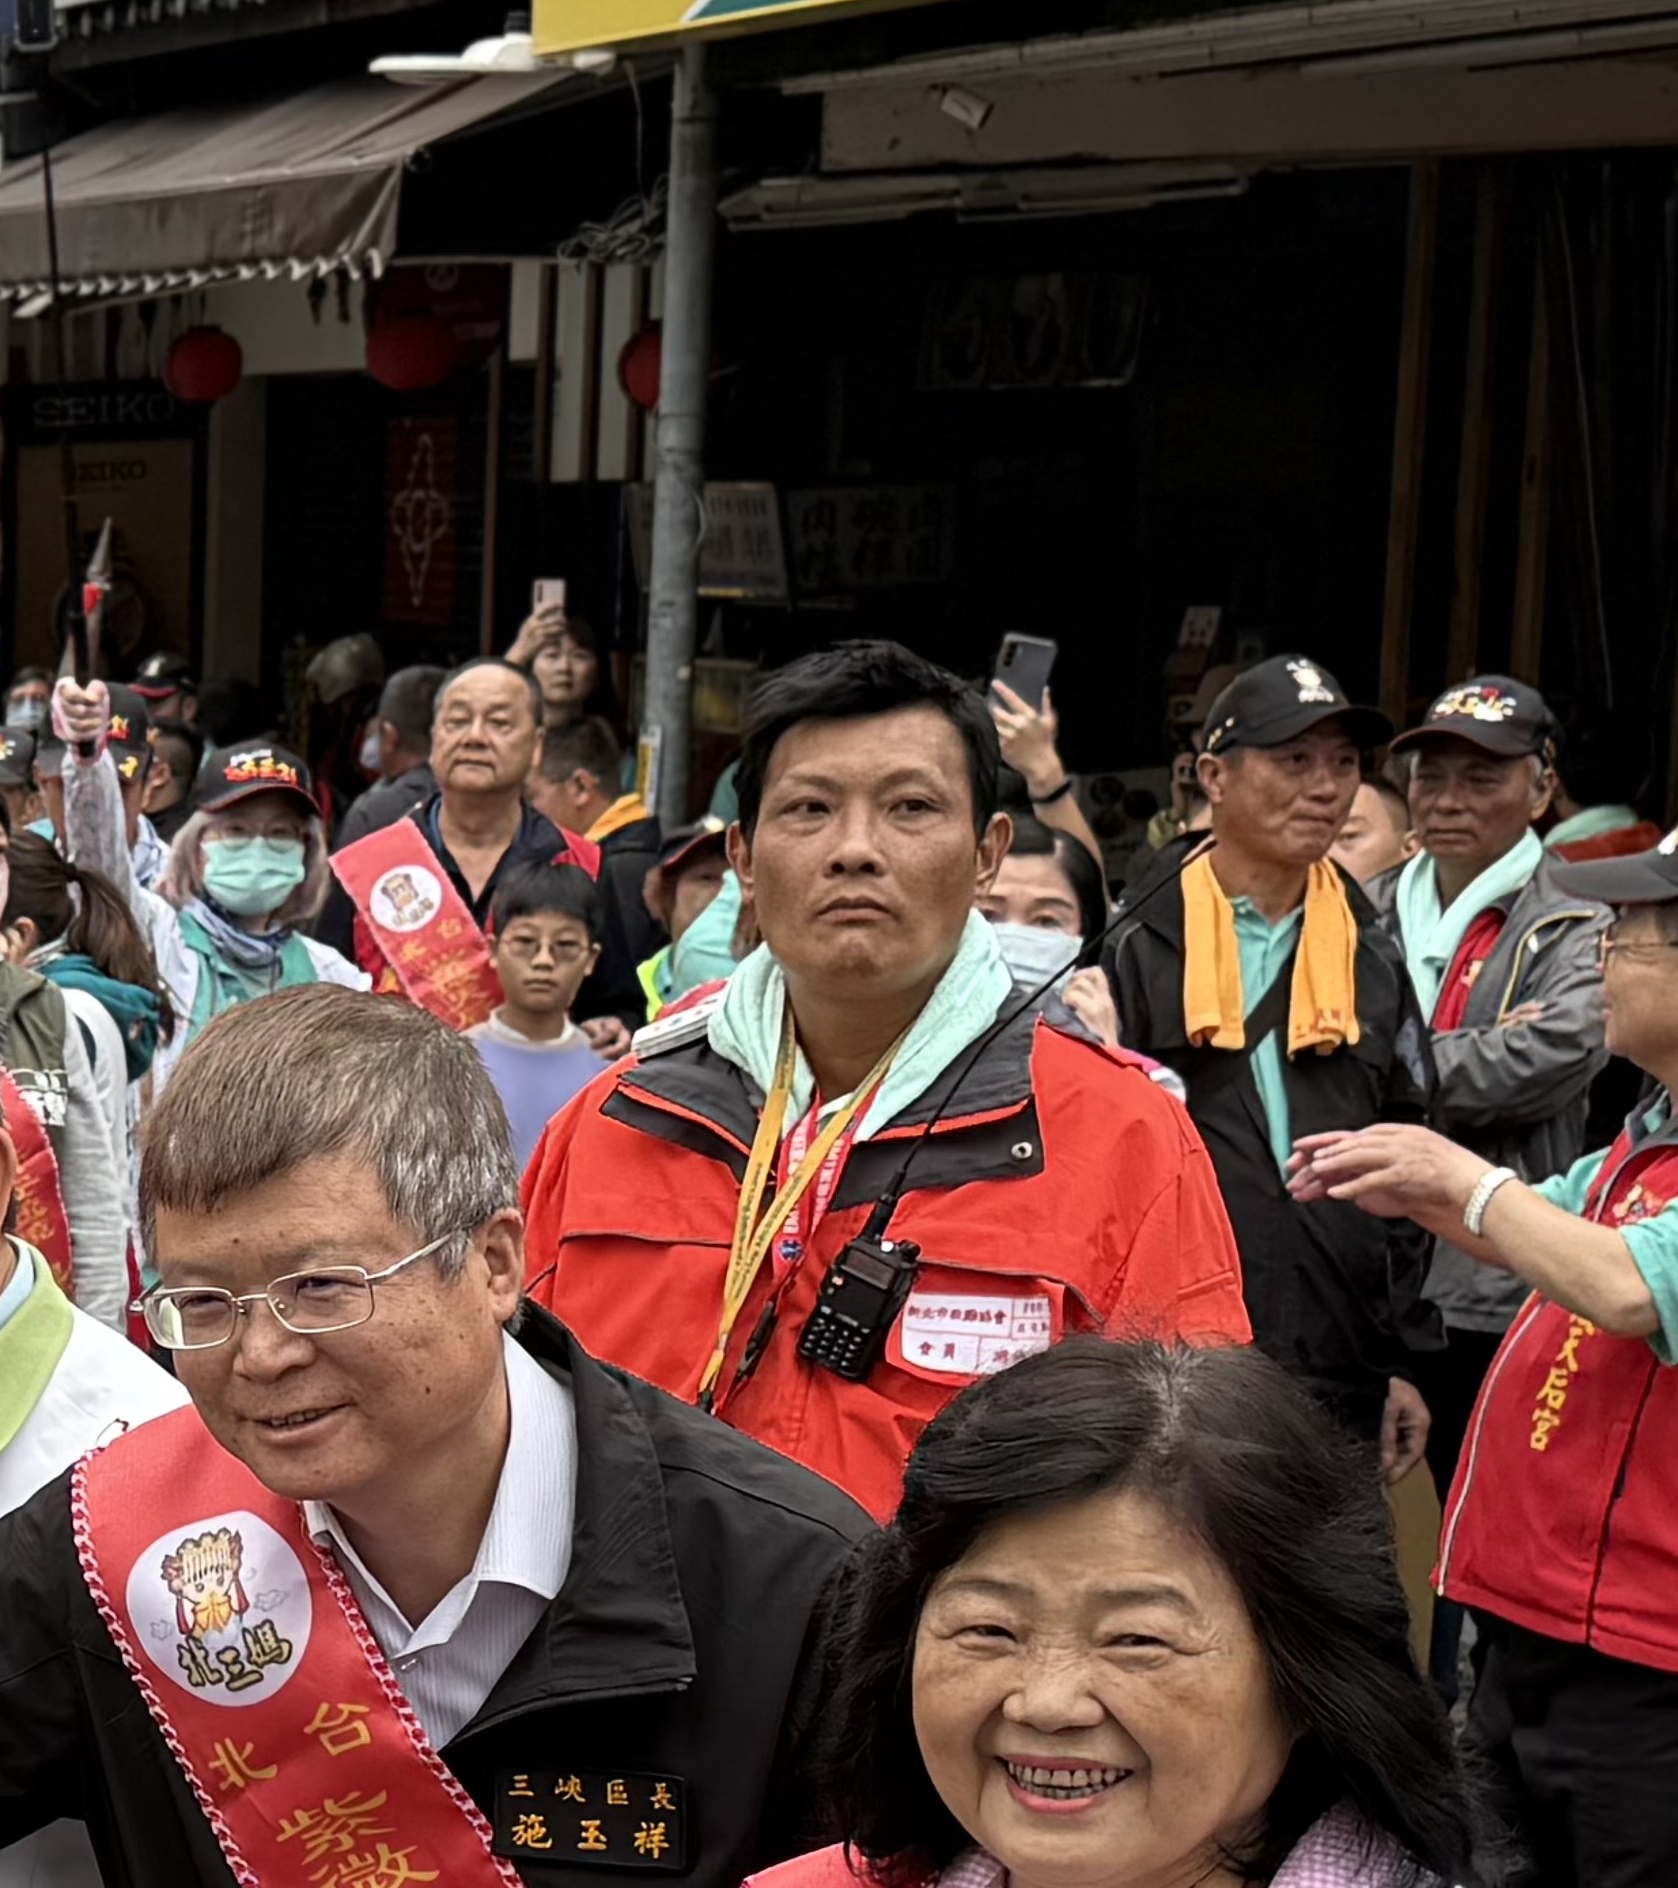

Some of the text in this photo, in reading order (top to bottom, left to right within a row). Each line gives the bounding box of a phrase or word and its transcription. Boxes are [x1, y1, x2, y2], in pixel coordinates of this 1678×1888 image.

[177, 1620, 293, 1691] 北三媽
[509, 1774, 676, 1810] 三峽區長
[512, 1814, 669, 1859] 施玉祥
